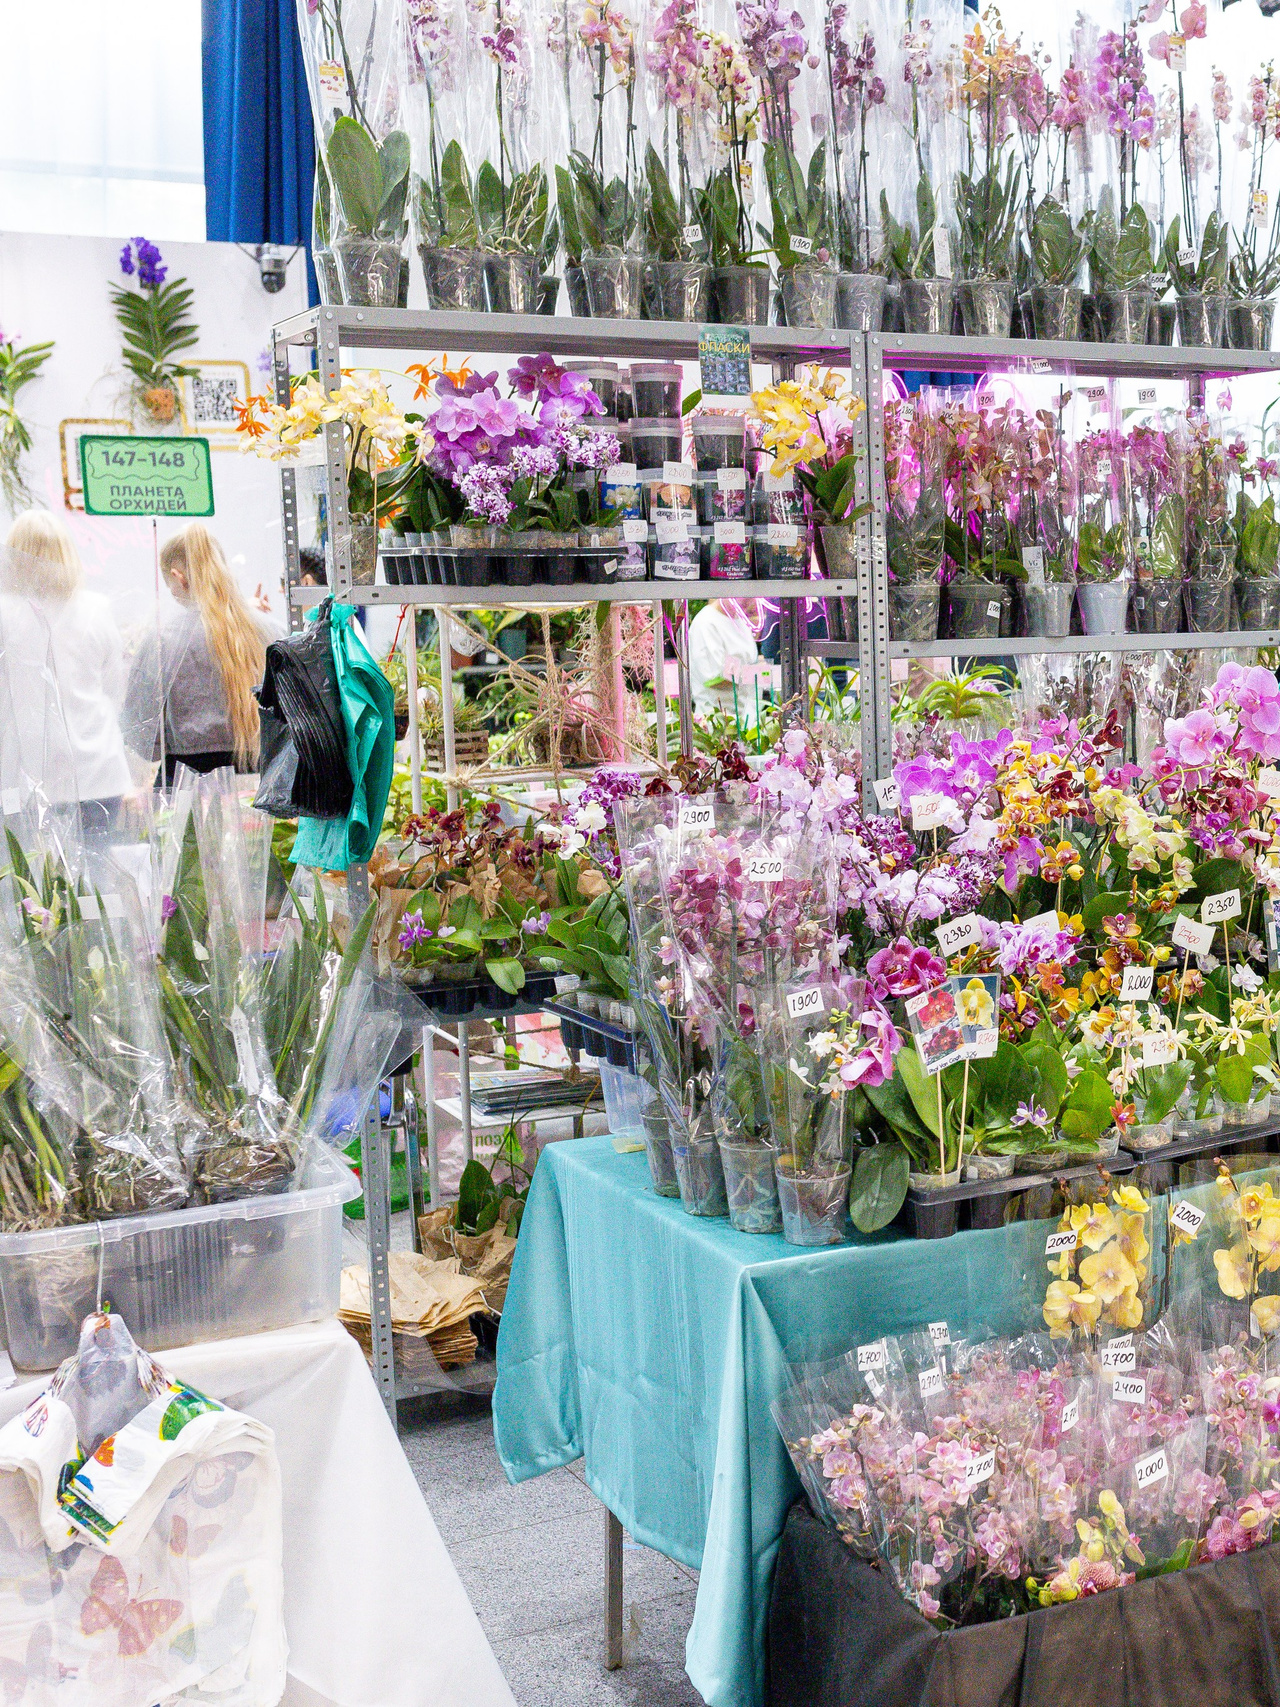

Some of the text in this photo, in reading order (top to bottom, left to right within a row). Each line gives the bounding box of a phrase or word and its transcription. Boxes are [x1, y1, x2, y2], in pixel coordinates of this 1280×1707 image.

[698, 341, 750, 353] ФЛАСКИ
[102, 451, 185, 467] 147-148
[110, 485, 184, 498] ПЛАНЕТА
[683, 810, 711, 825] 2900
[750, 861, 782, 875] 2500
[1127, 975, 1152, 992] 2000
[792, 991, 819, 1011] 1900
[1175, 1206, 1201, 1226] 2000
[1047, 1234, 1077, 1249] 2000
[858, 1351, 881, 1365] 2700
[1103, 1352, 1134, 1366] 2700
[1114, 1381, 1143, 1395] 2400
[967, 1457, 994, 1477] 2700
[1137, 1457, 1164, 1482] 2000
